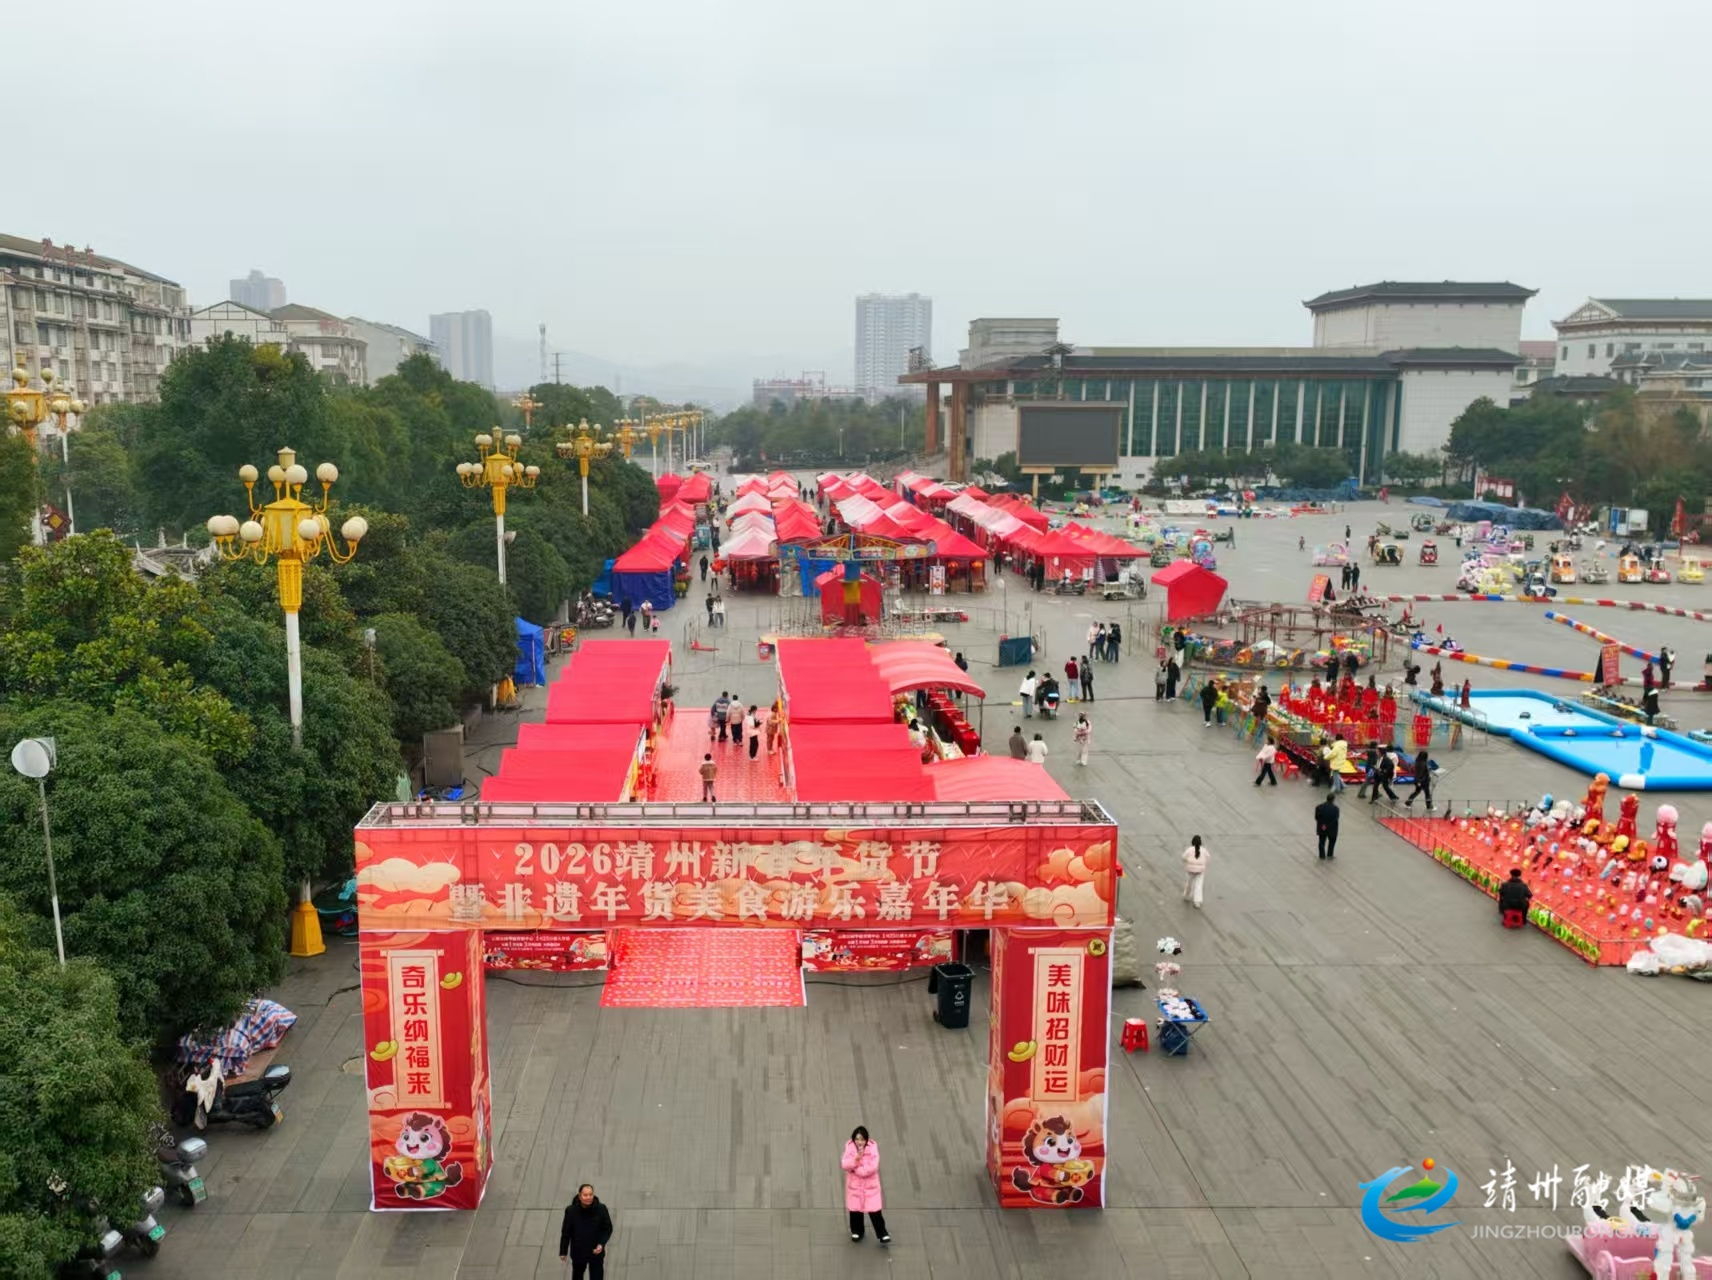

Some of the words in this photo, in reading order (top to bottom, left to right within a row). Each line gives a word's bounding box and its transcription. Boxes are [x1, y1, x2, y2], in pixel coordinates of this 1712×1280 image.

[449, 881, 1009, 922] 暨非遗年货美食游乐嘉年华
[401, 965, 431, 1095] 奇乐纳福来
[1044, 964, 1071, 1093] 美味招财运
